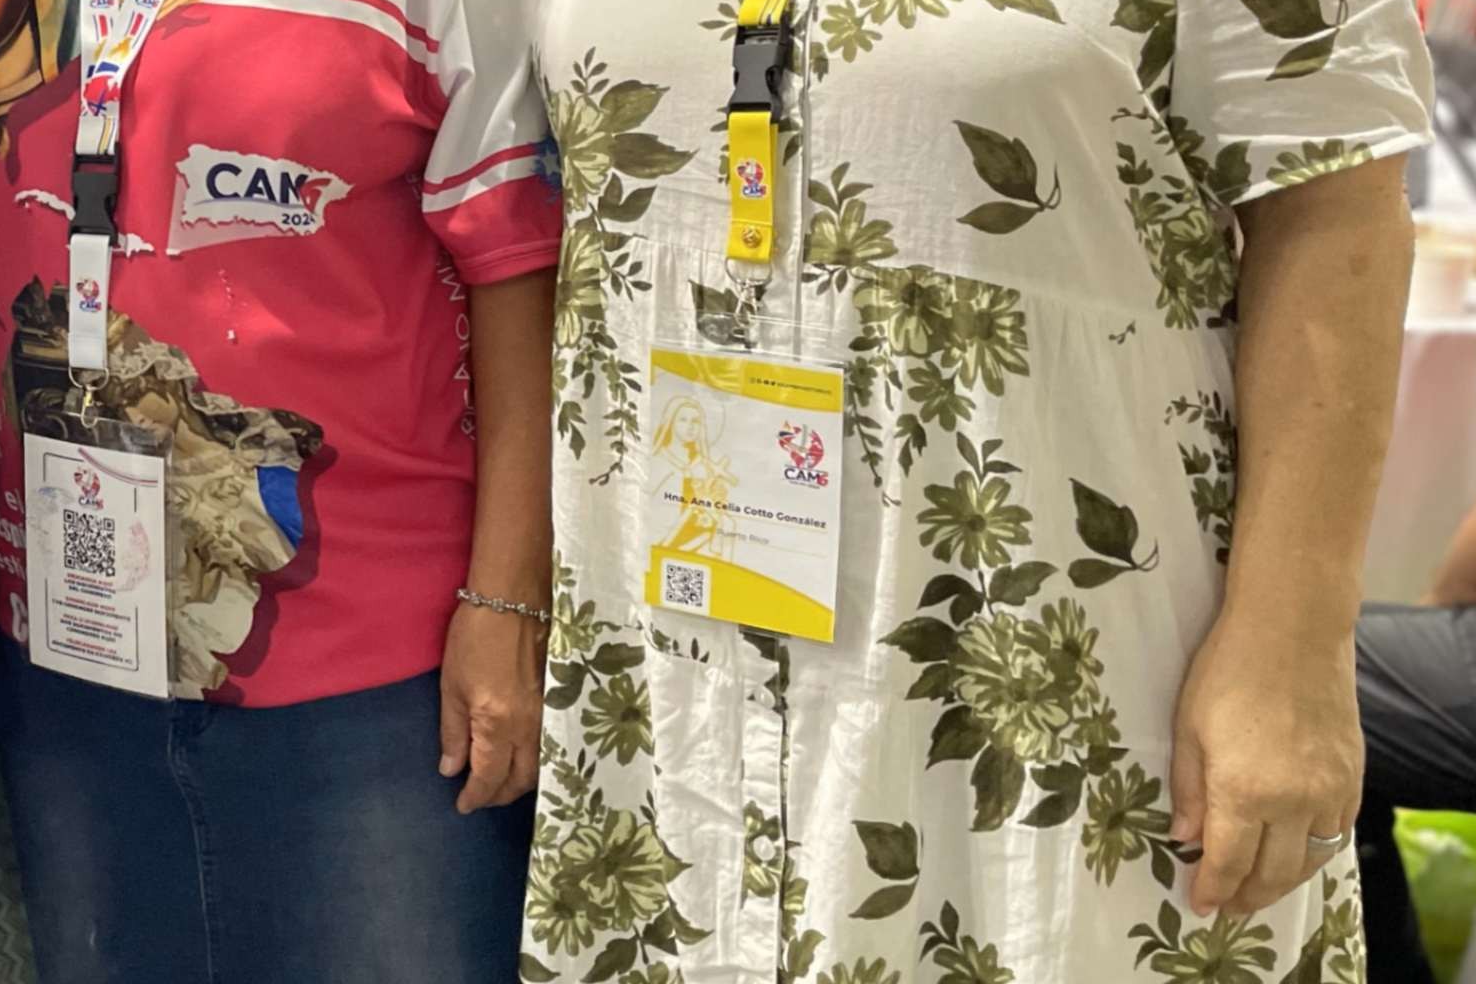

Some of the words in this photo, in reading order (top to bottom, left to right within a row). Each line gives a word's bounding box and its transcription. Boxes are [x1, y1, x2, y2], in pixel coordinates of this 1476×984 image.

[784, 467, 829, 488] CAM6
[664, 492, 688, 504] Hna.
[691, 497, 712, 508] Ana
[714, 501, 741, 513] Celia
[743, 506, 774, 519] Cotto
[776, 512, 827, 529] González
